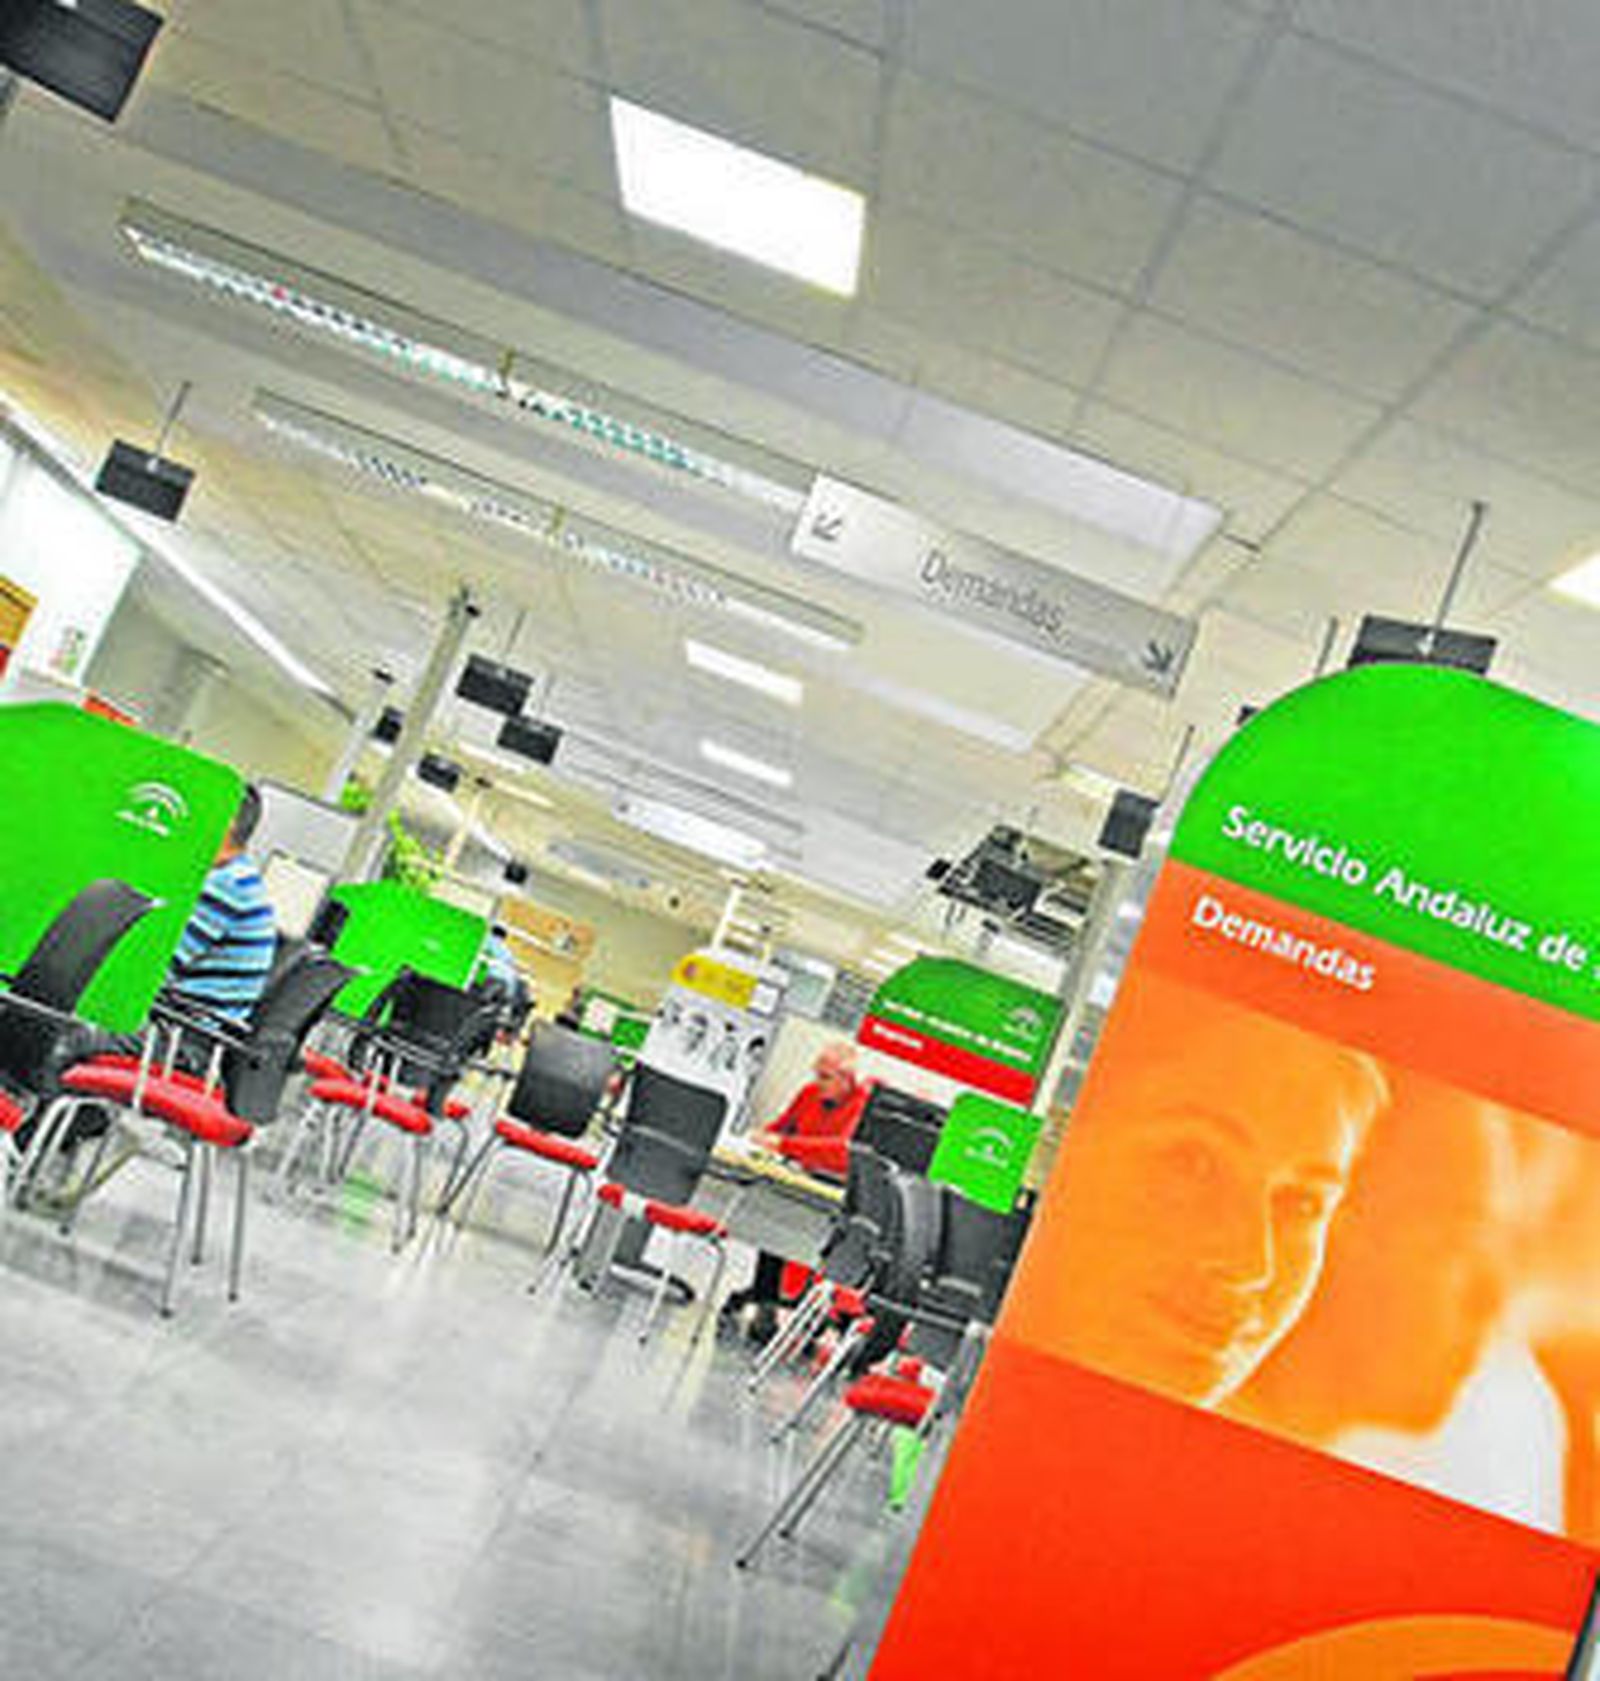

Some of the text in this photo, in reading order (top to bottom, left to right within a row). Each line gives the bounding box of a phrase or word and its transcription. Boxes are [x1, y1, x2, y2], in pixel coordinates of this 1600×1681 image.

[920, 548, 1065, 634] Demandas
[1221, 805, 1588, 971] Servicio Andaluz de
[1191, 896, 1375, 991] Demandas
